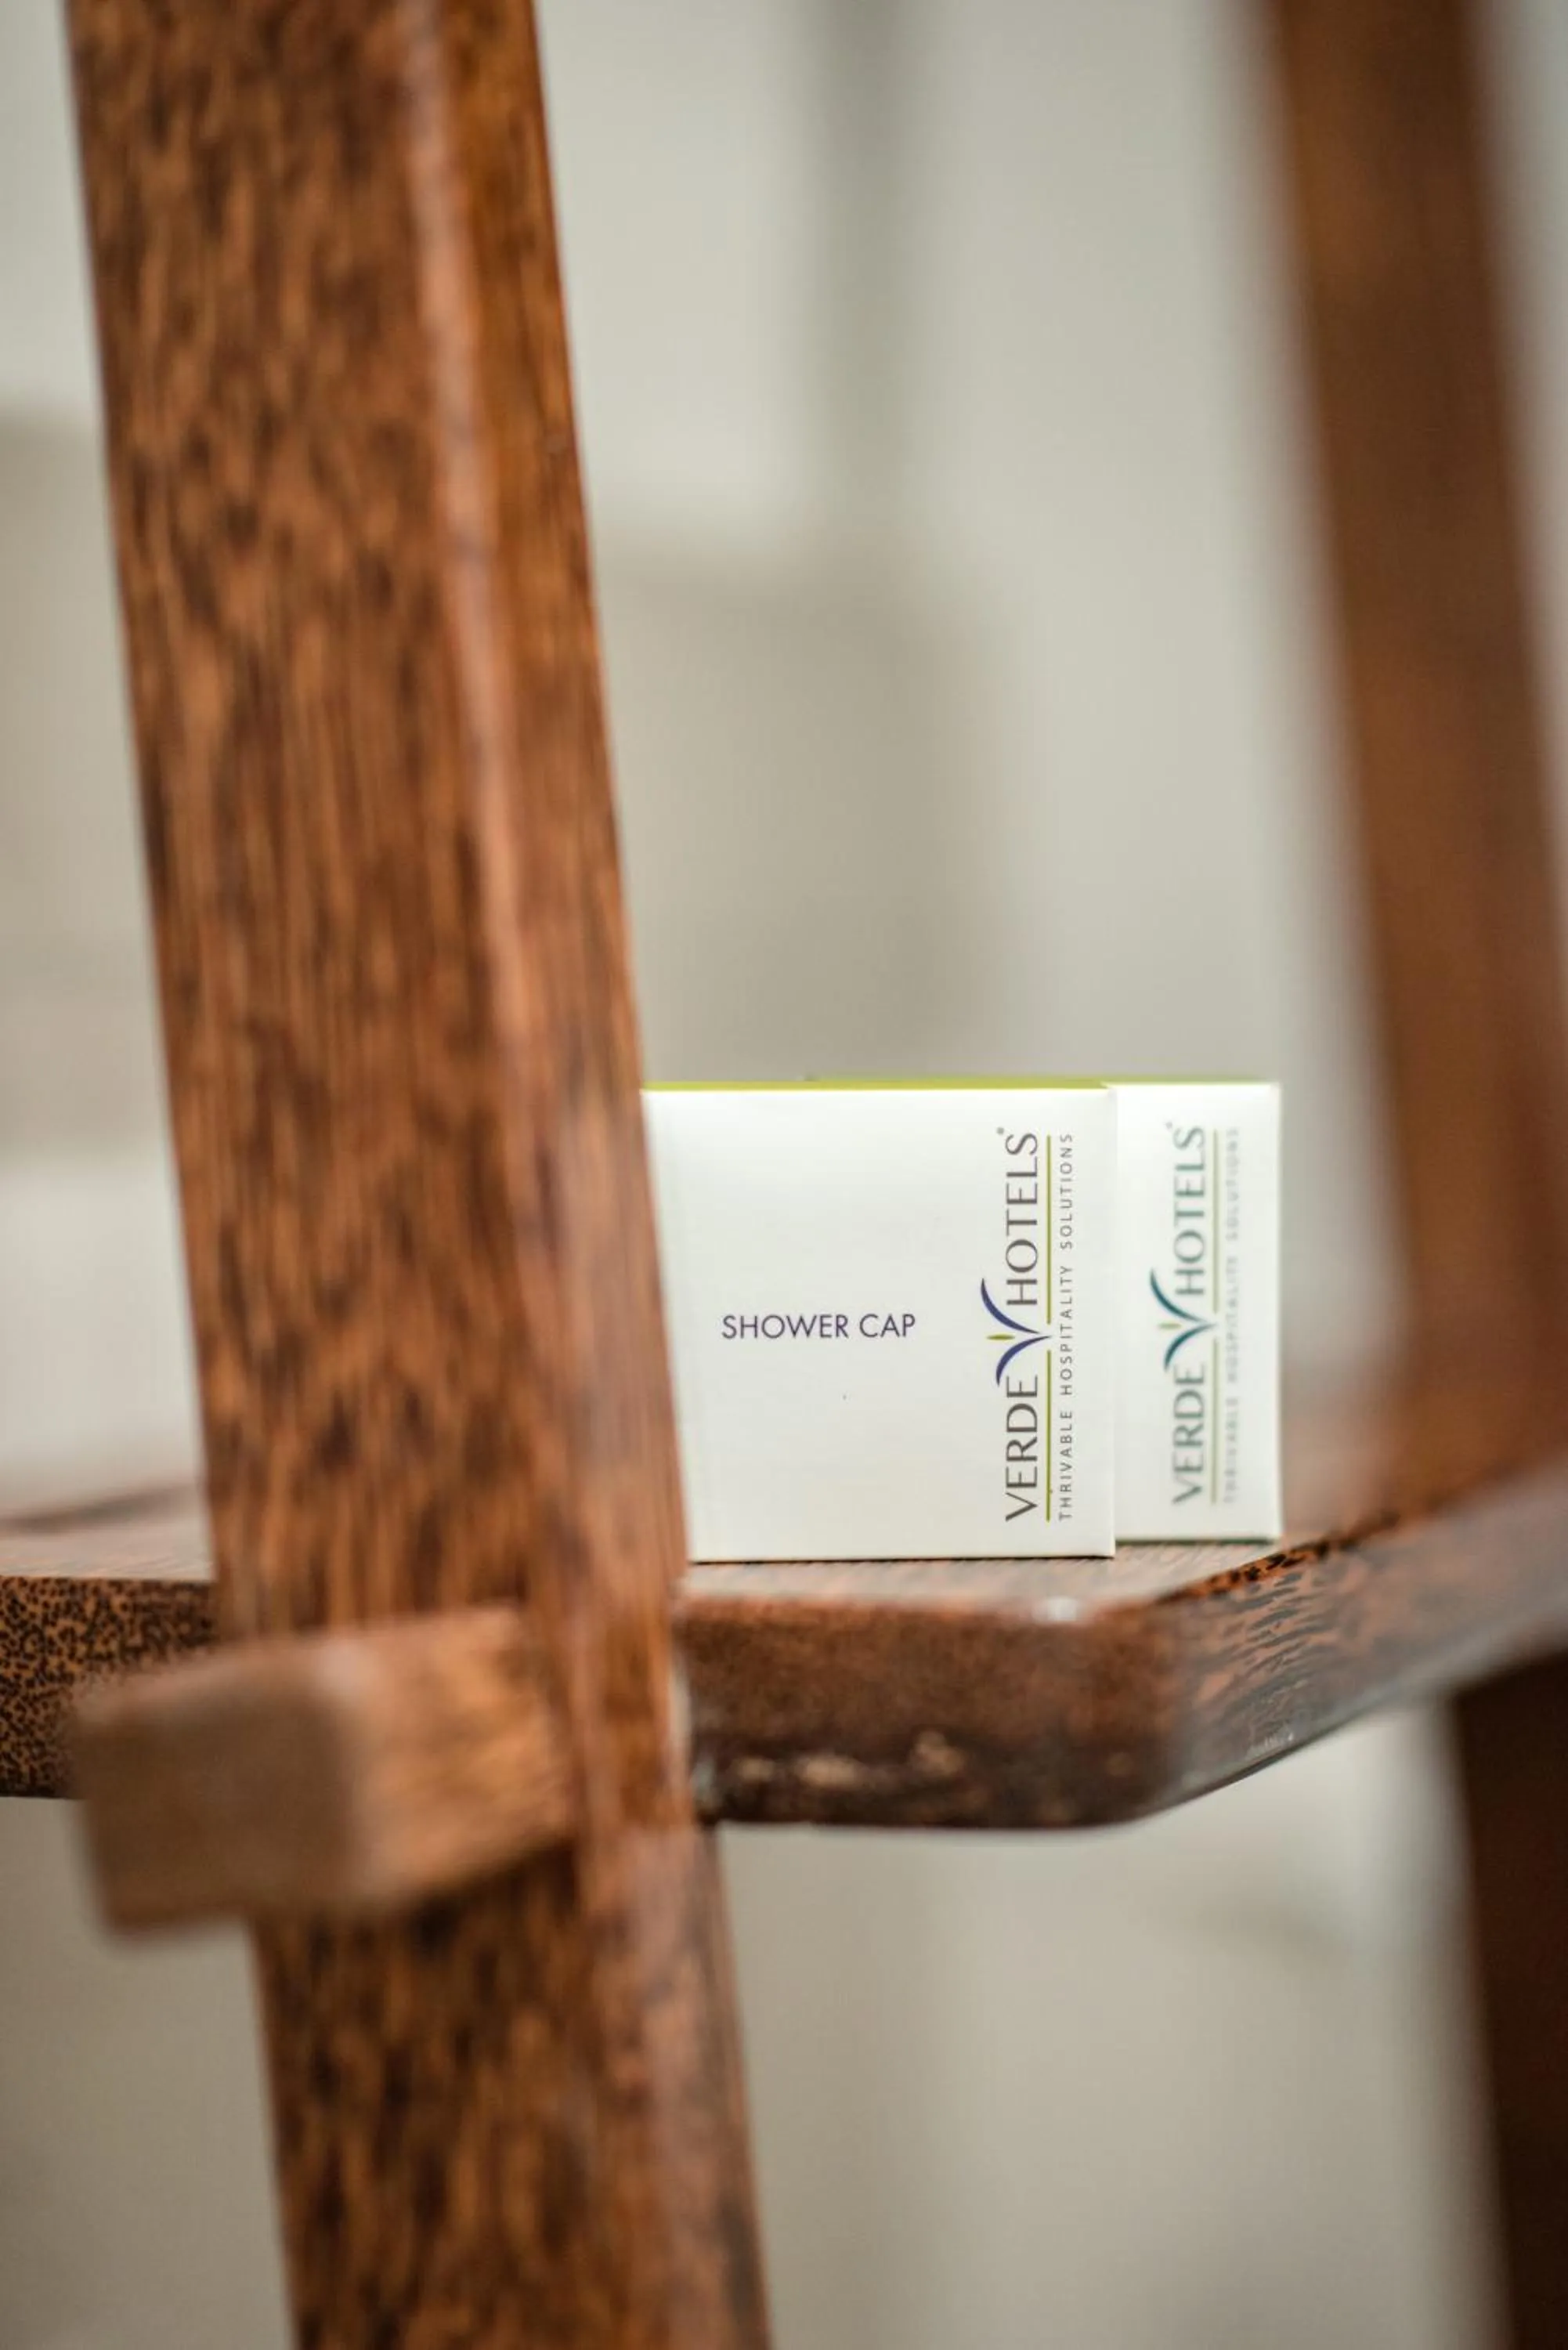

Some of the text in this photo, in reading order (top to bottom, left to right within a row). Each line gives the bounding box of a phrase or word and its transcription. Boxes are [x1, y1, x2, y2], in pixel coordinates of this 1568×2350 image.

[721, 1314, 916, 1340] SHOWER CAP
[1005, 1132, 1039, 1522] VERDE HOTELS
[1059, 1133, 1073, 1521] THRIVABLE HOSPITALITY SOLUTIONS
[1172, 1126, 1205, 1505] VERDE HOTELS
